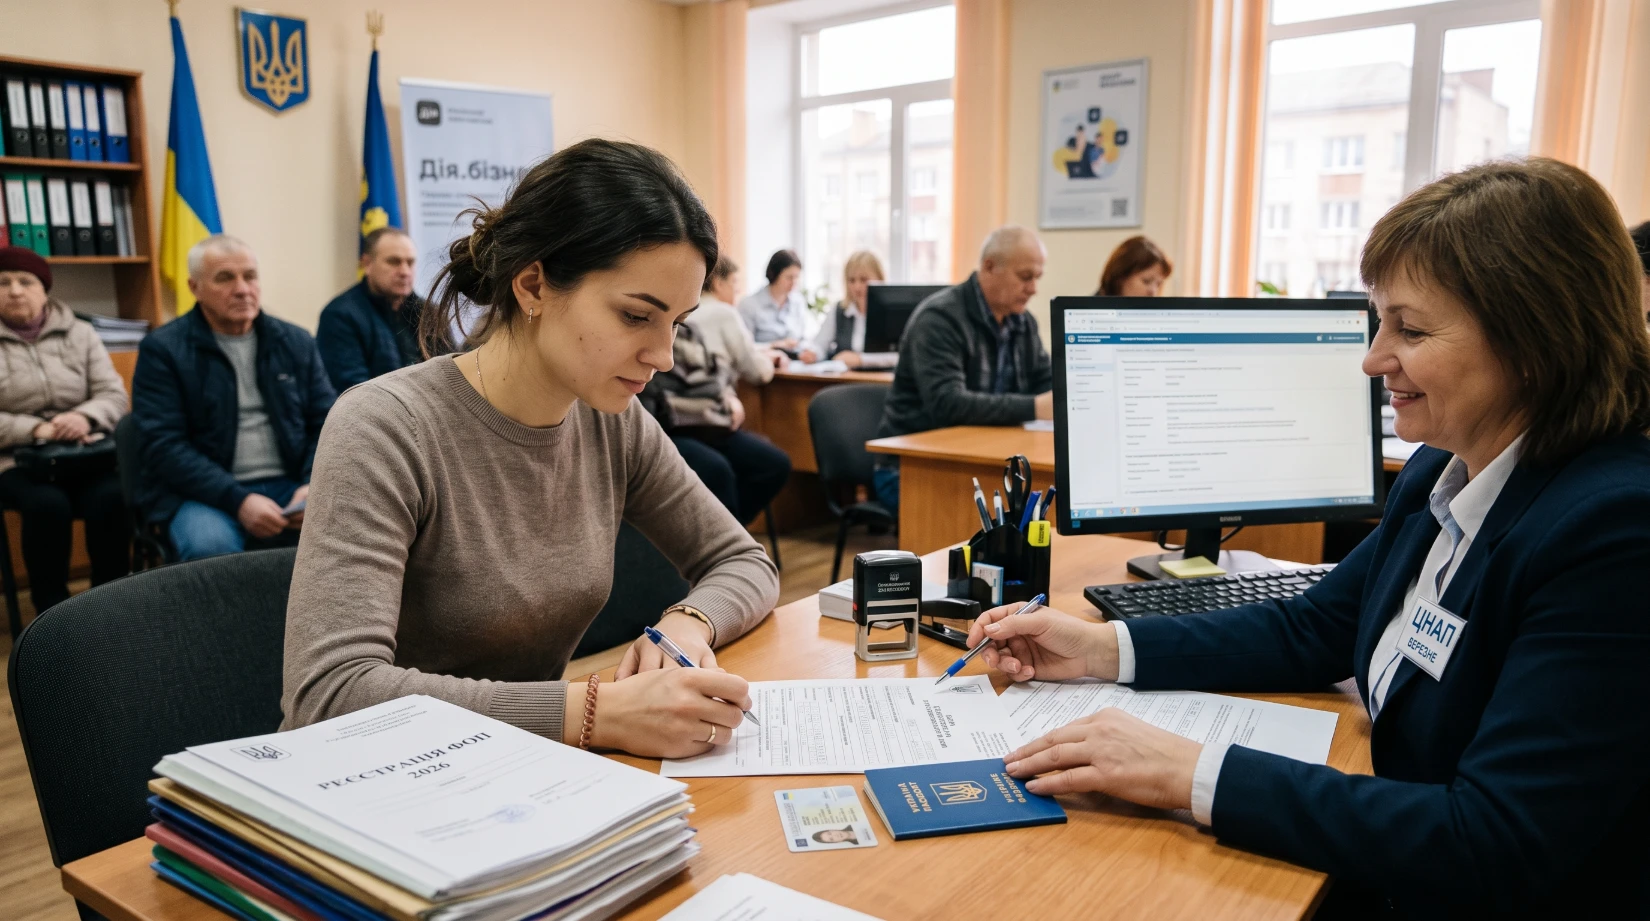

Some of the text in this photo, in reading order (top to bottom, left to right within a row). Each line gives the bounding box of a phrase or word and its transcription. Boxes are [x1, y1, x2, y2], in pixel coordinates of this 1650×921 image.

[419, 158, 523, 181] Дія.бізн
[1412, 606, 1457, 648] ЦНАП
[447, 732, 492, 750] ФОП
[407, 762, 451, 779] 2026
